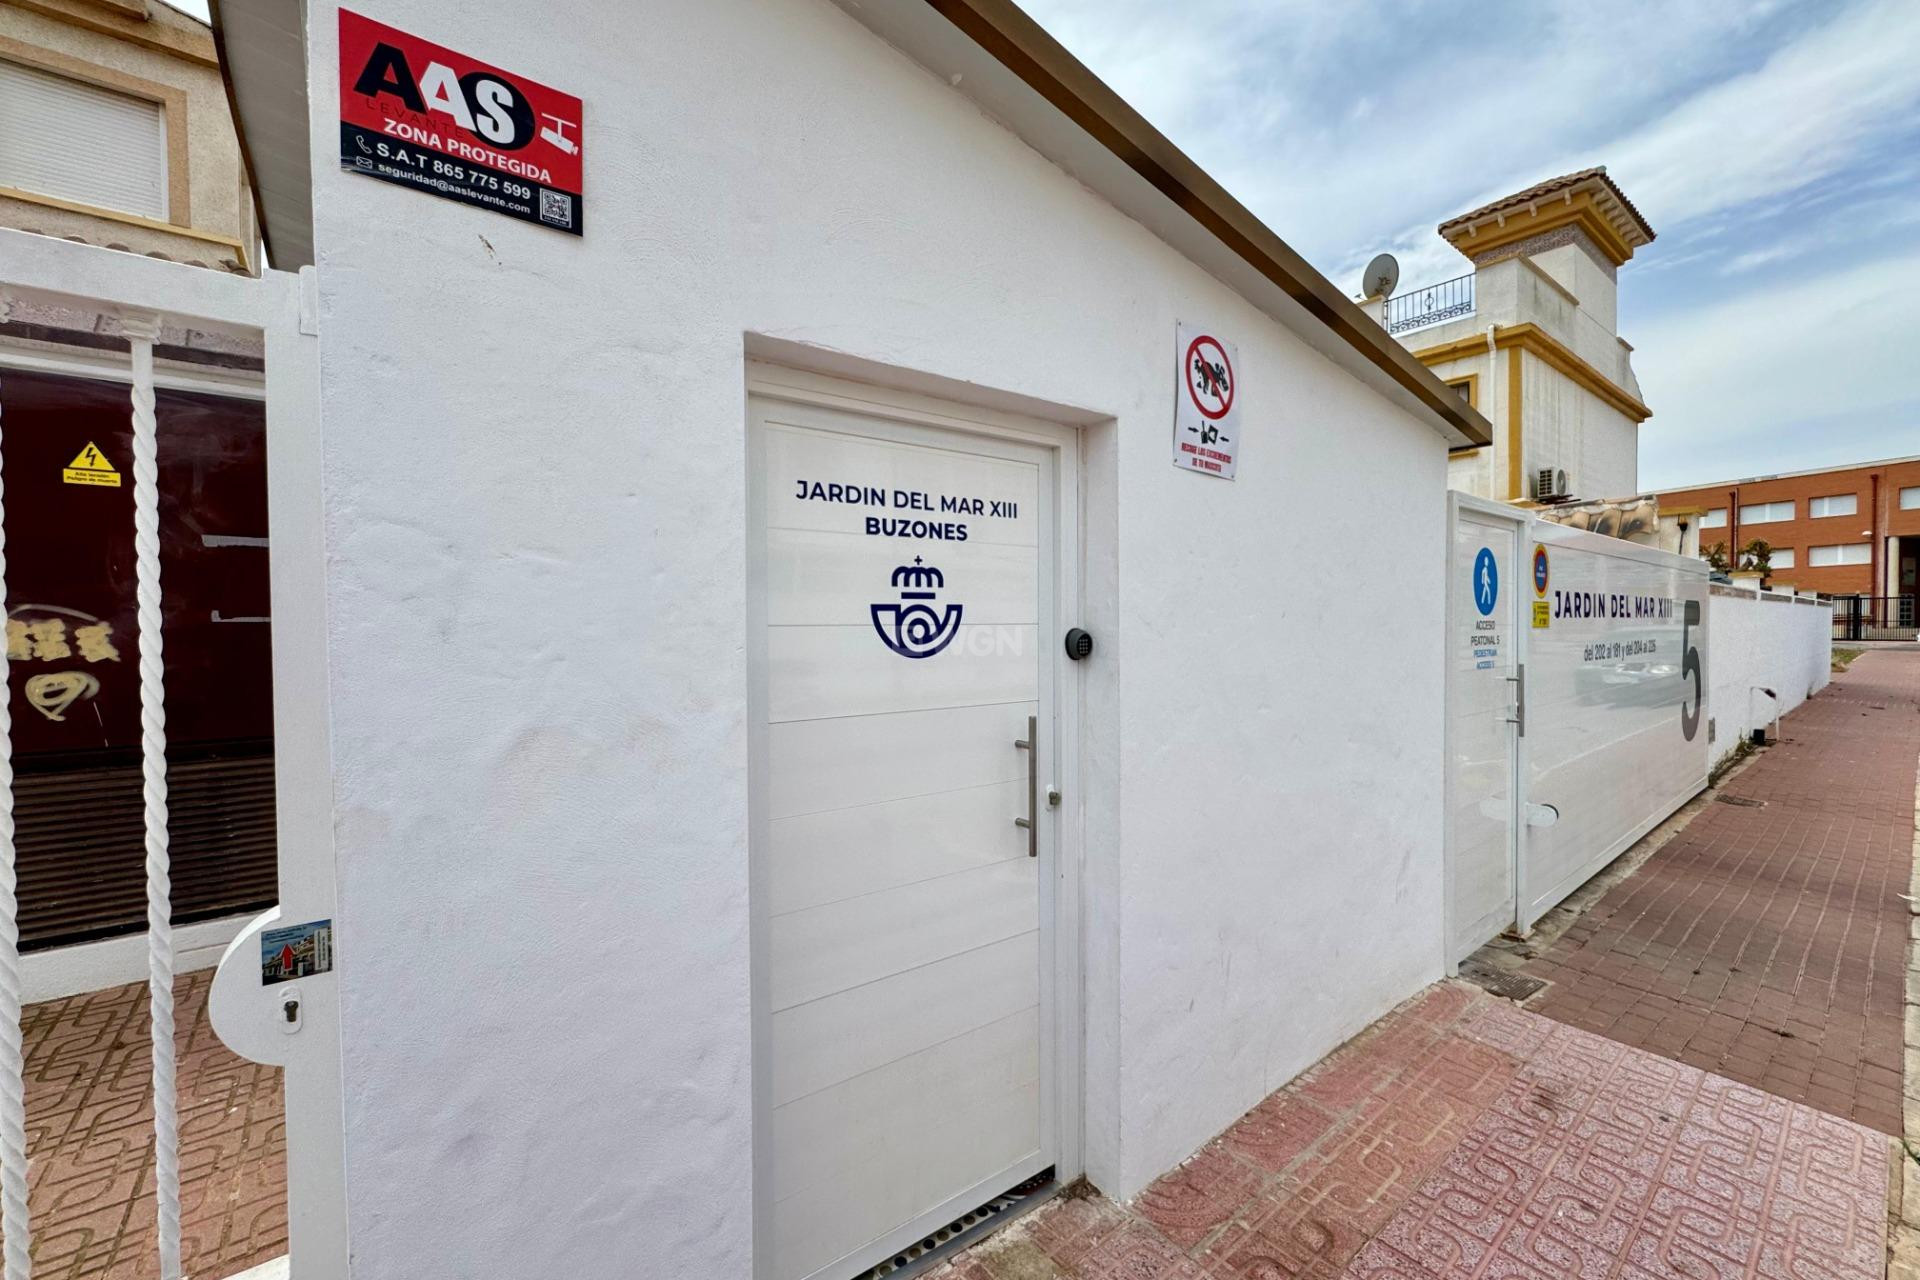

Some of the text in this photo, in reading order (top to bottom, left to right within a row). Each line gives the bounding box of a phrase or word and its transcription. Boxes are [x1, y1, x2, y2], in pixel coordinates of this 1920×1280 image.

[353, 41, 515, 144] AAS
[367, 99, 465, 138] LEVANTE
[383, 118, 552, 184] ZONA PROTEGIDA
[377, 143, 531, 199] S.A.T 865 775 599
[378, 163, 531, 214] seguridad@aaslevante.com
[796, 480, 1017, 519] JARDIN DEL MAR XIII
[865, 517, 968, 541] BUZONES
[1555, 591, 1605, 618] JARDIN
[1611, 594, 1631, 618] DEL
[1636, 597, 1654, 618] MAR
[1658, 598, 1672, 618] XIII
[1471, 634, 1496, 646] PEATONAL
[1476, 620, 1495, 630] ACCESO
[1584, 644, 1594, 661] del
[1682, 600, 1701, 742] 5
